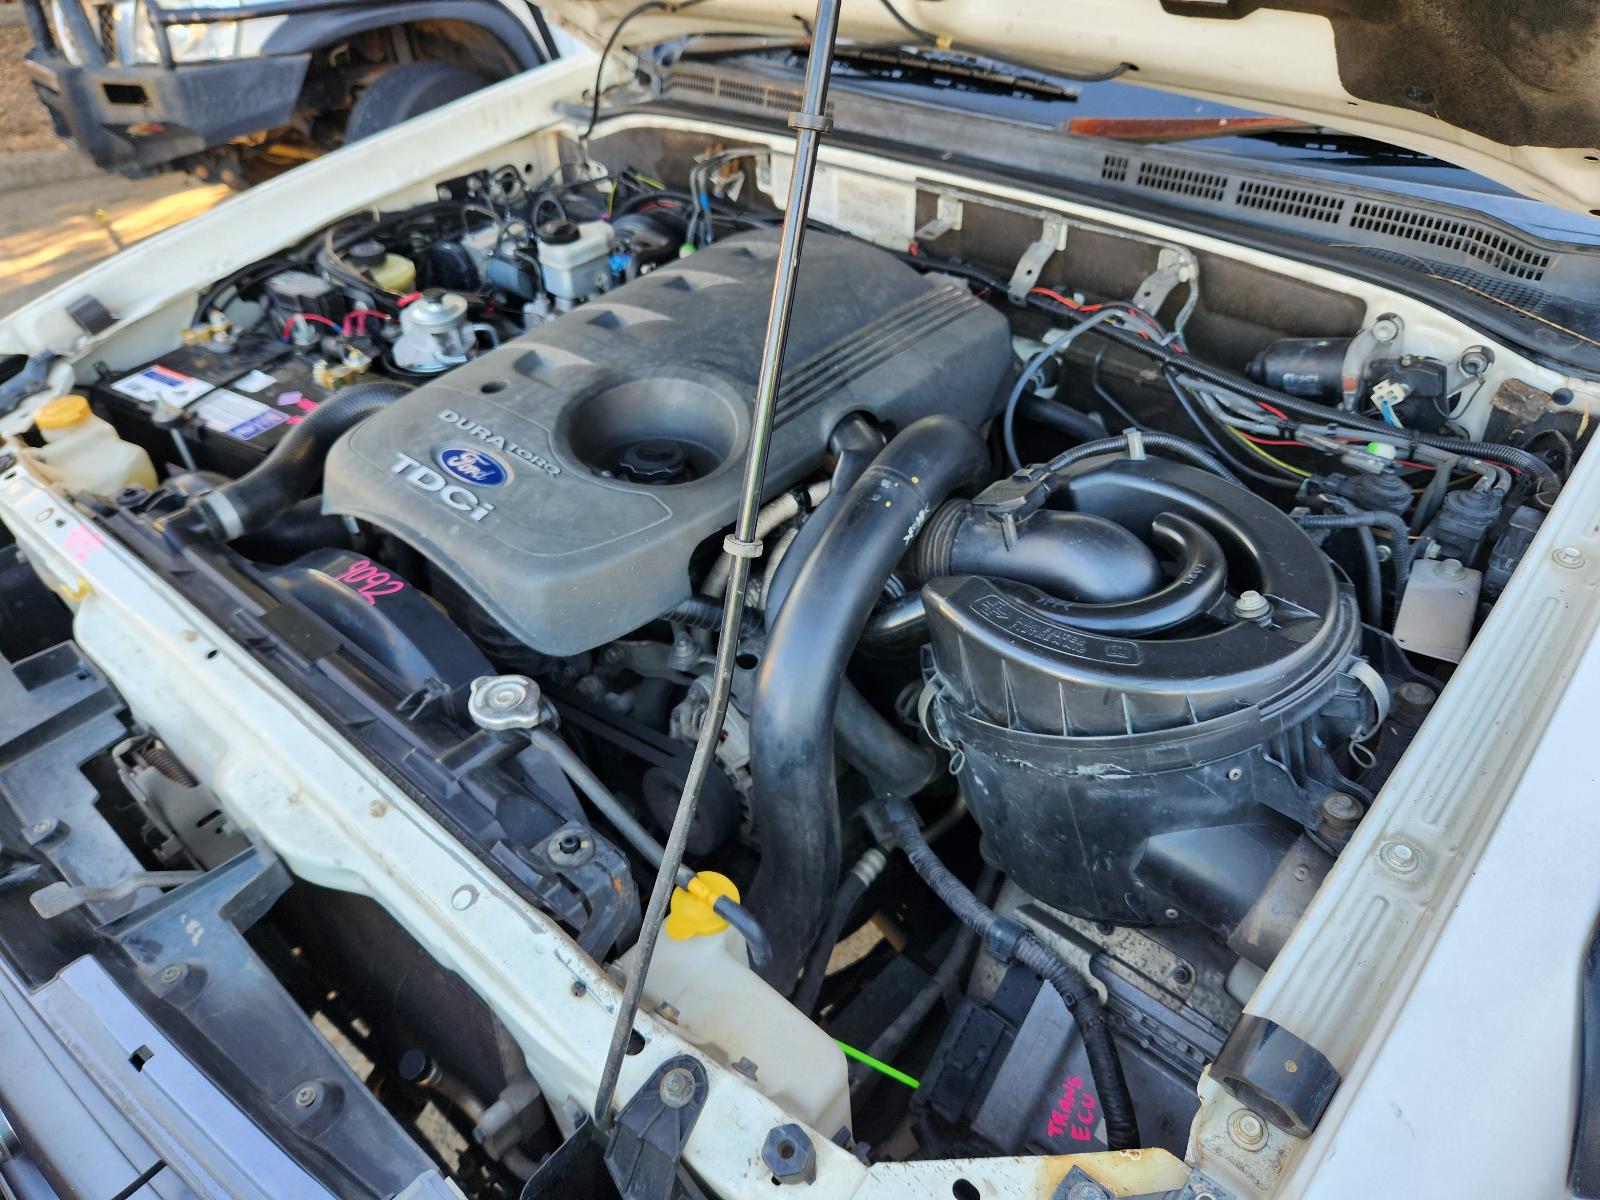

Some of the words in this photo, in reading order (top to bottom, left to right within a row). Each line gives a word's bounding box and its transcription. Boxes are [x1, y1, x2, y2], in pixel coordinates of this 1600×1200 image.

[392, 452, 495, 521] TDCi
[447, 450, 498, 481] Ford
[1048, 1076, 1082, 1137] TRANS
[1071, 1092, 1096, 1141] ECU
